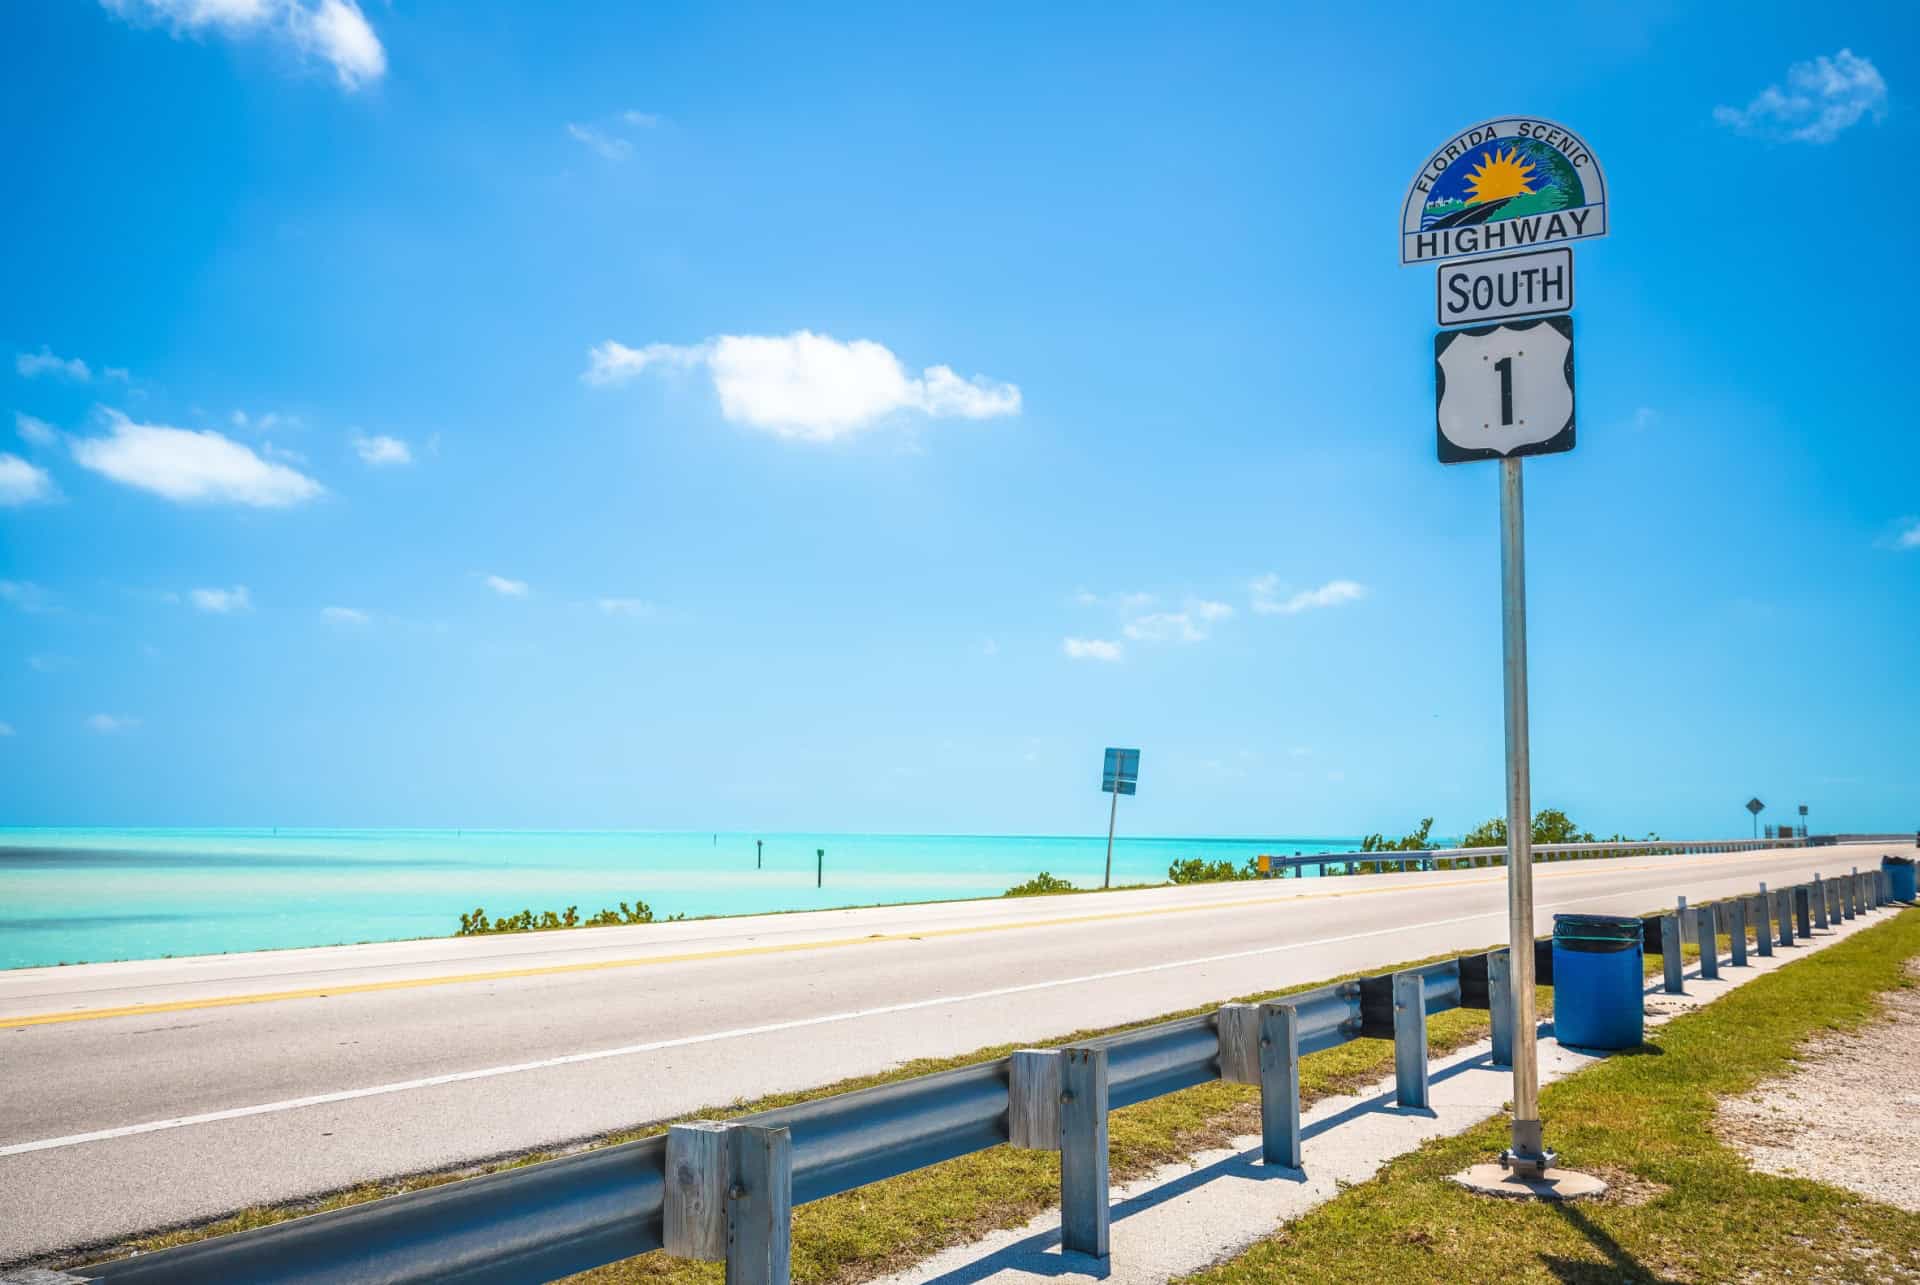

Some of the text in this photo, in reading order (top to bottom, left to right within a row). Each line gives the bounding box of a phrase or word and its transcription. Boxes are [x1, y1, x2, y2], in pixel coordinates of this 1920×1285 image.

[1416, 122, 1589, 194] FLORIDA SCENIC
[1416, 209, 1591, 258] HIGHWAY
[1447, 265, 1563, 314] SOUTH
[1494, 356, 1514, 426] 1
